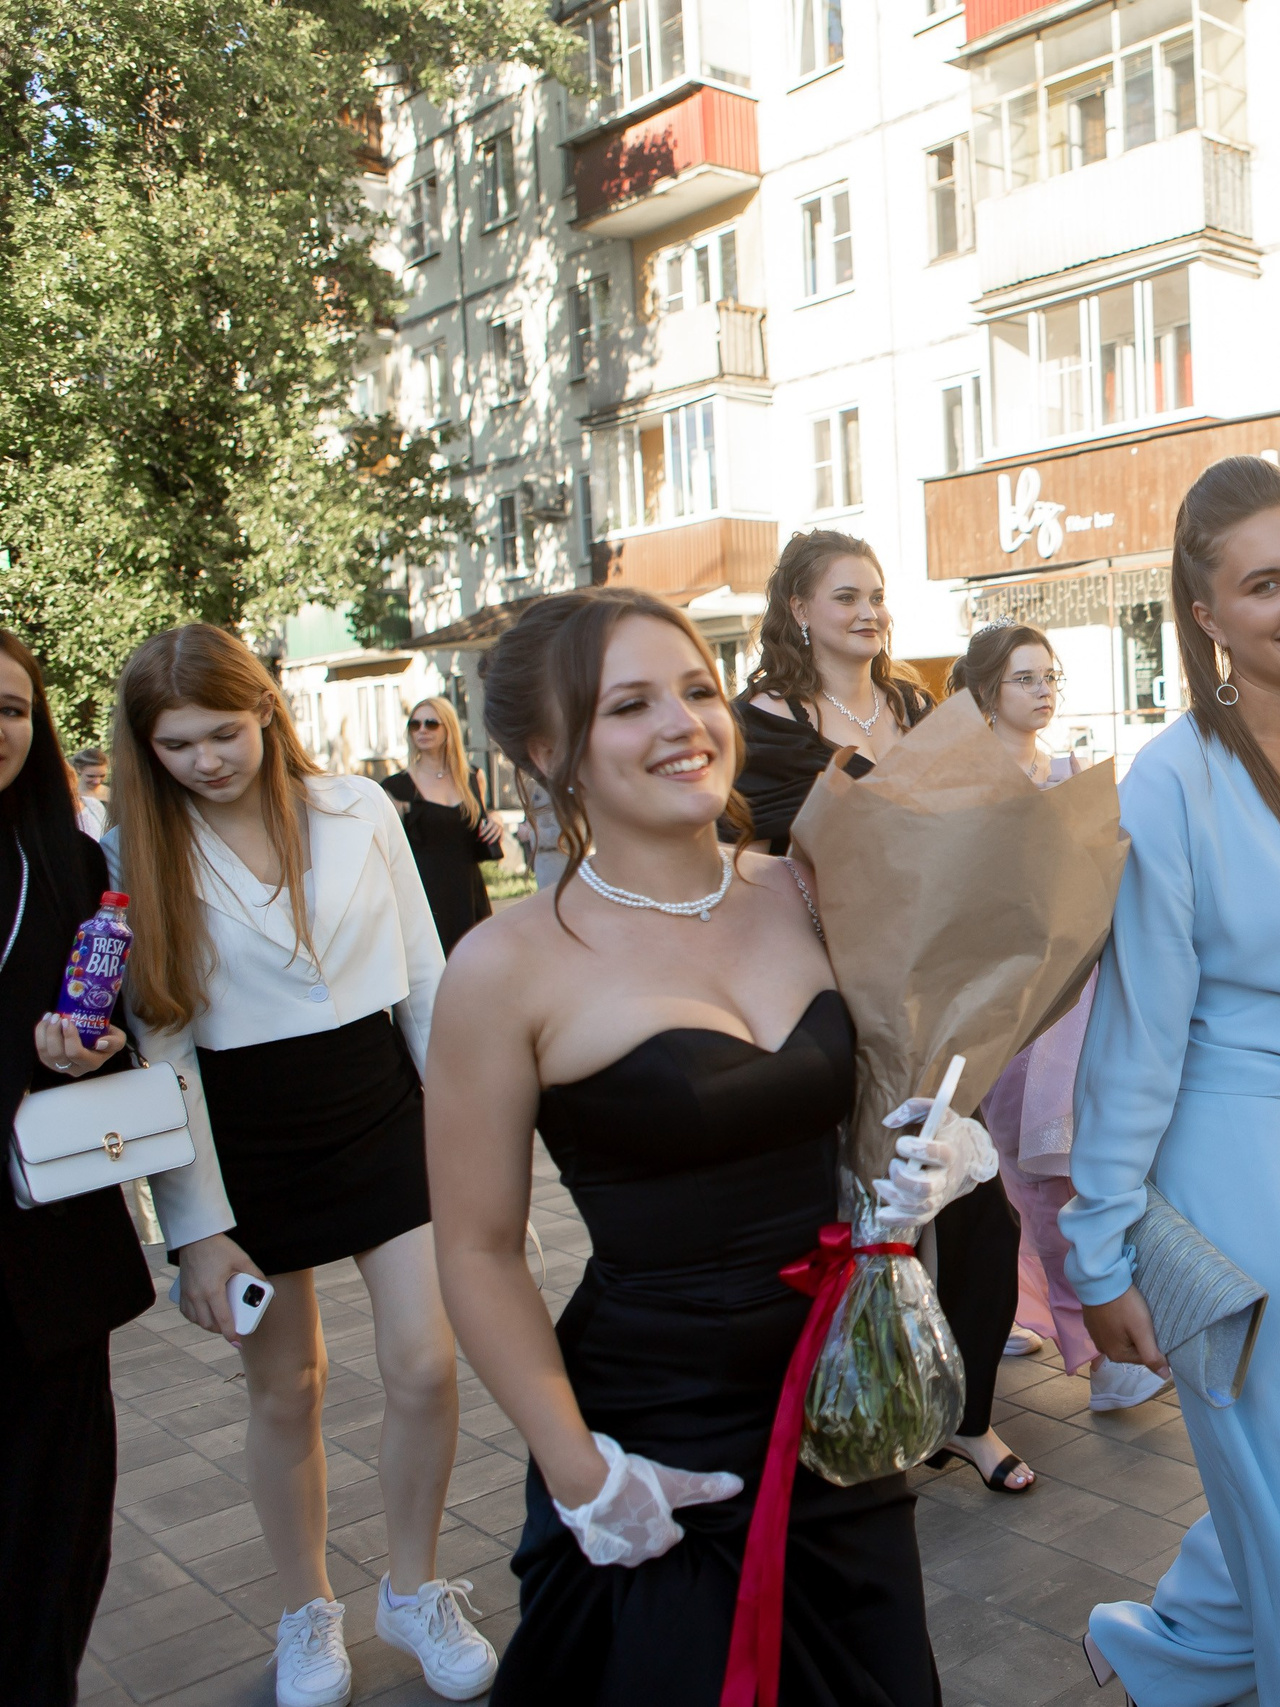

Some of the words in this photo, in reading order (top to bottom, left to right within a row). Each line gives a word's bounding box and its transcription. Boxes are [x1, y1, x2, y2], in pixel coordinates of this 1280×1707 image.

[93, 937, 126, 956] FRESH
[86, 952, 120, 977] BAR
[71, 1012, 106, 1023] MAGIC
